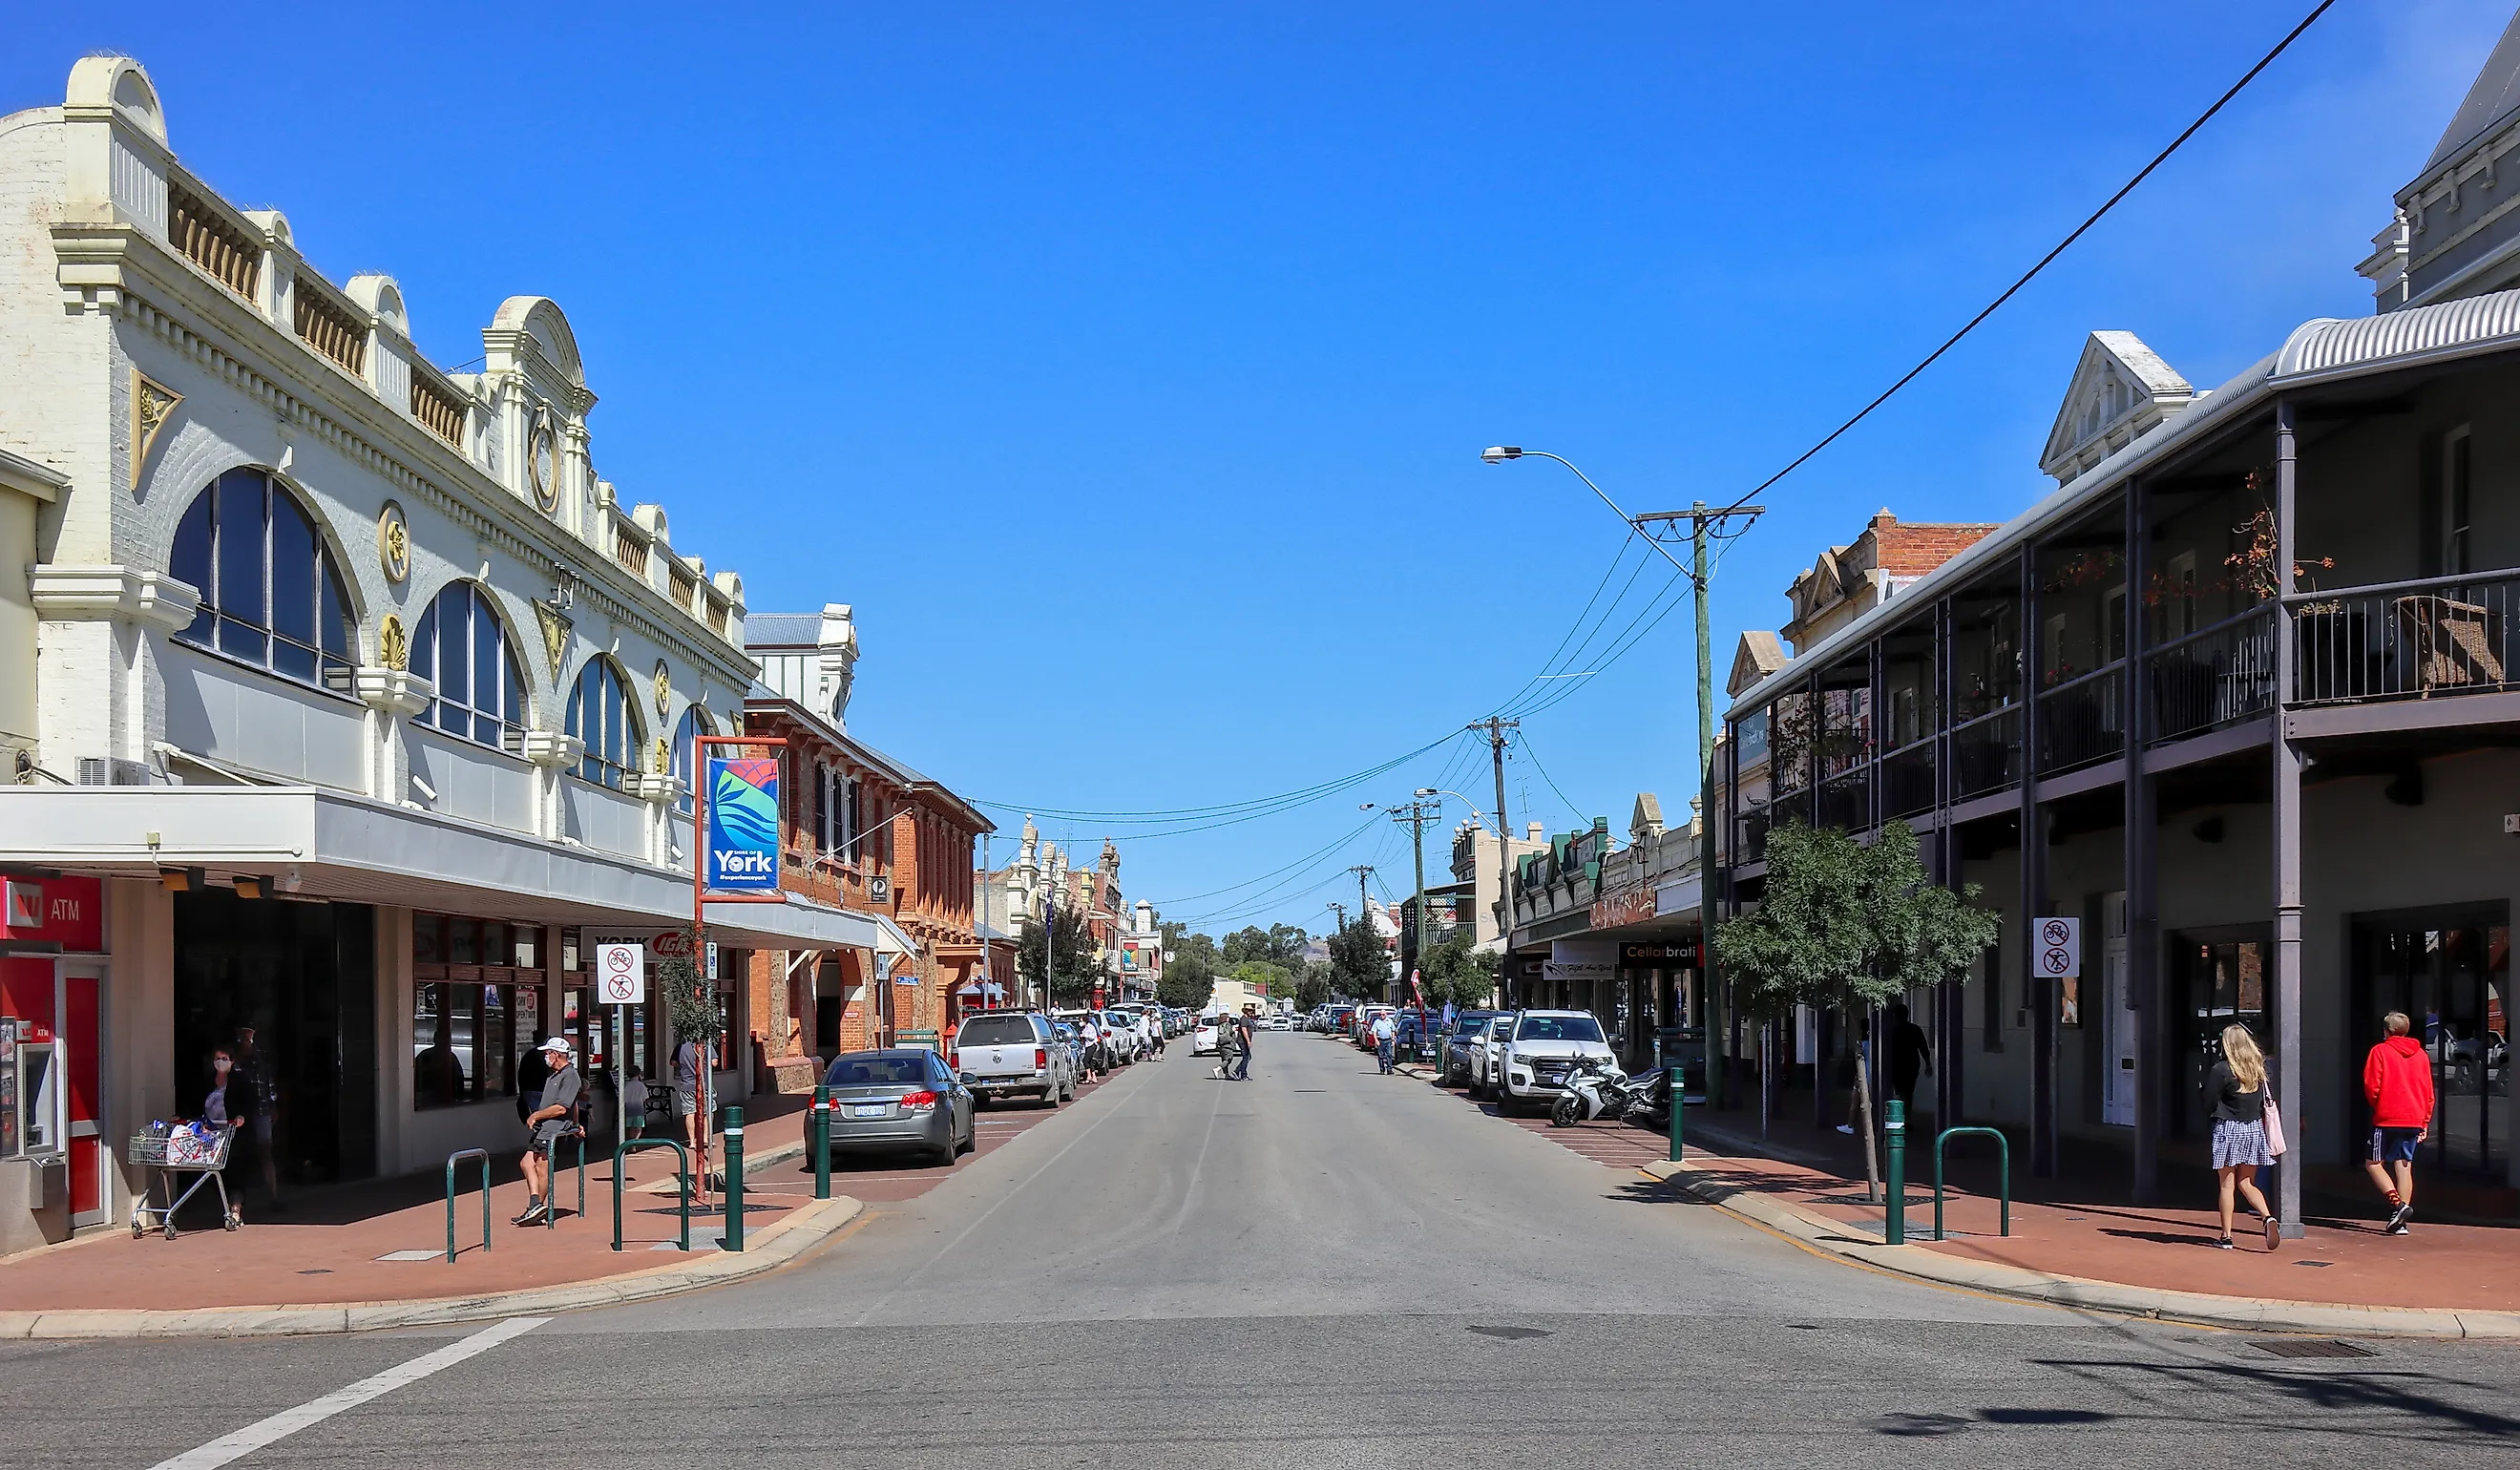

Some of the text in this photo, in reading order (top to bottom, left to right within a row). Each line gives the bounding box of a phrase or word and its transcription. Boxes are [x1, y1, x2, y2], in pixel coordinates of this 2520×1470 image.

[714, 850, 773, 872] York
[51, 898, 80, 921] ATM
[1627, 946, 1696, 957] Cellarbrati
[36, 1028, 50, 1037] ATM
